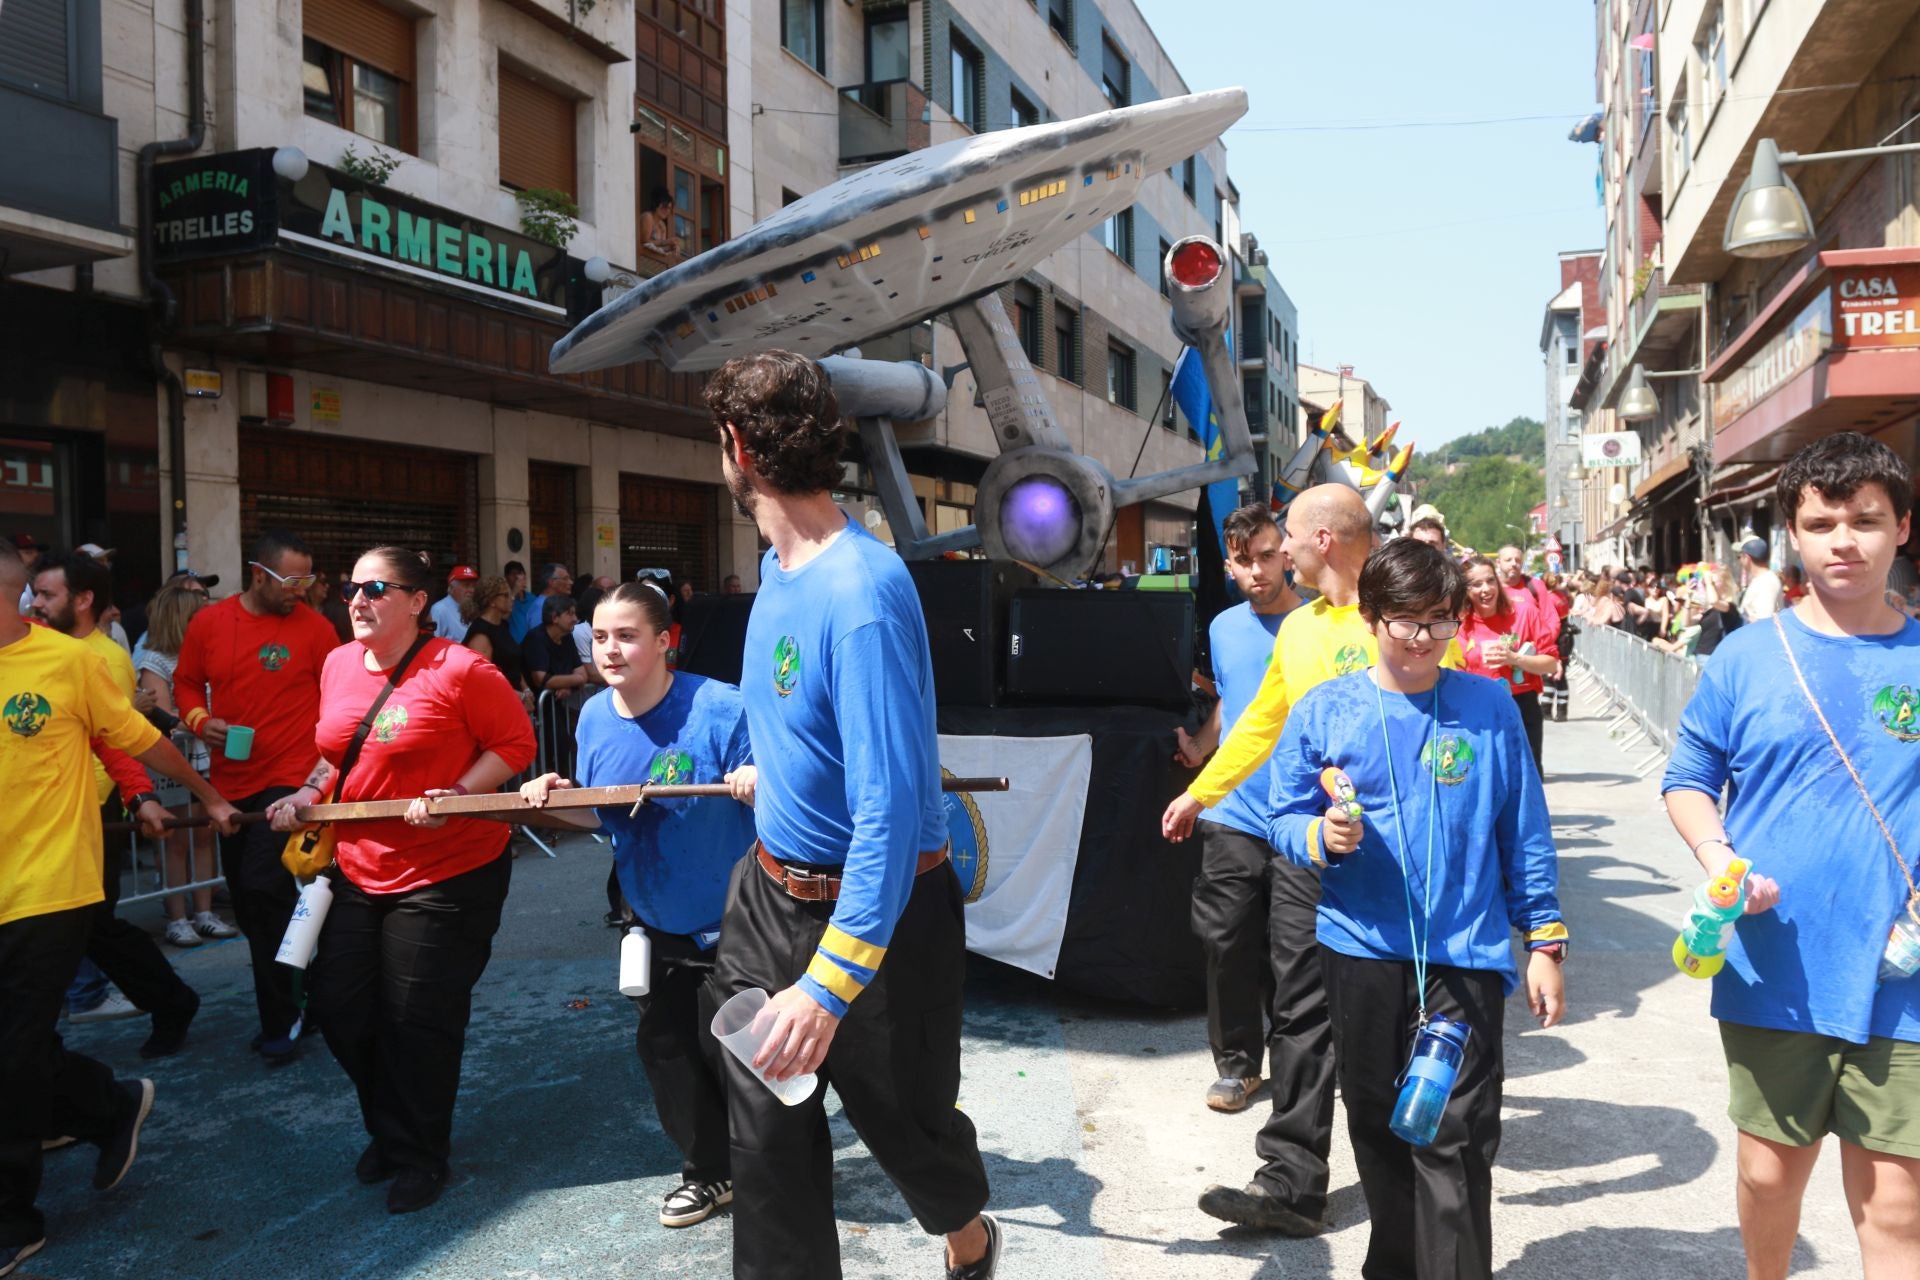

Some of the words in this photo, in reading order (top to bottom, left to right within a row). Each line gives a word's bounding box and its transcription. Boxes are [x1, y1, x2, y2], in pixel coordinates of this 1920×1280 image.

[160, 171, 249, 208] ARMERIA
[156, 210, 254, 243] TRELLES
[320, 187, 538, 297] ARMERIA
[1840, 277, 1898, 298] CASA
[1840, 309, 1920, 336] TREL
[1588, 457, 1638, 466] BUNKAI
[1011, 634, 1020, 655] ALTO
